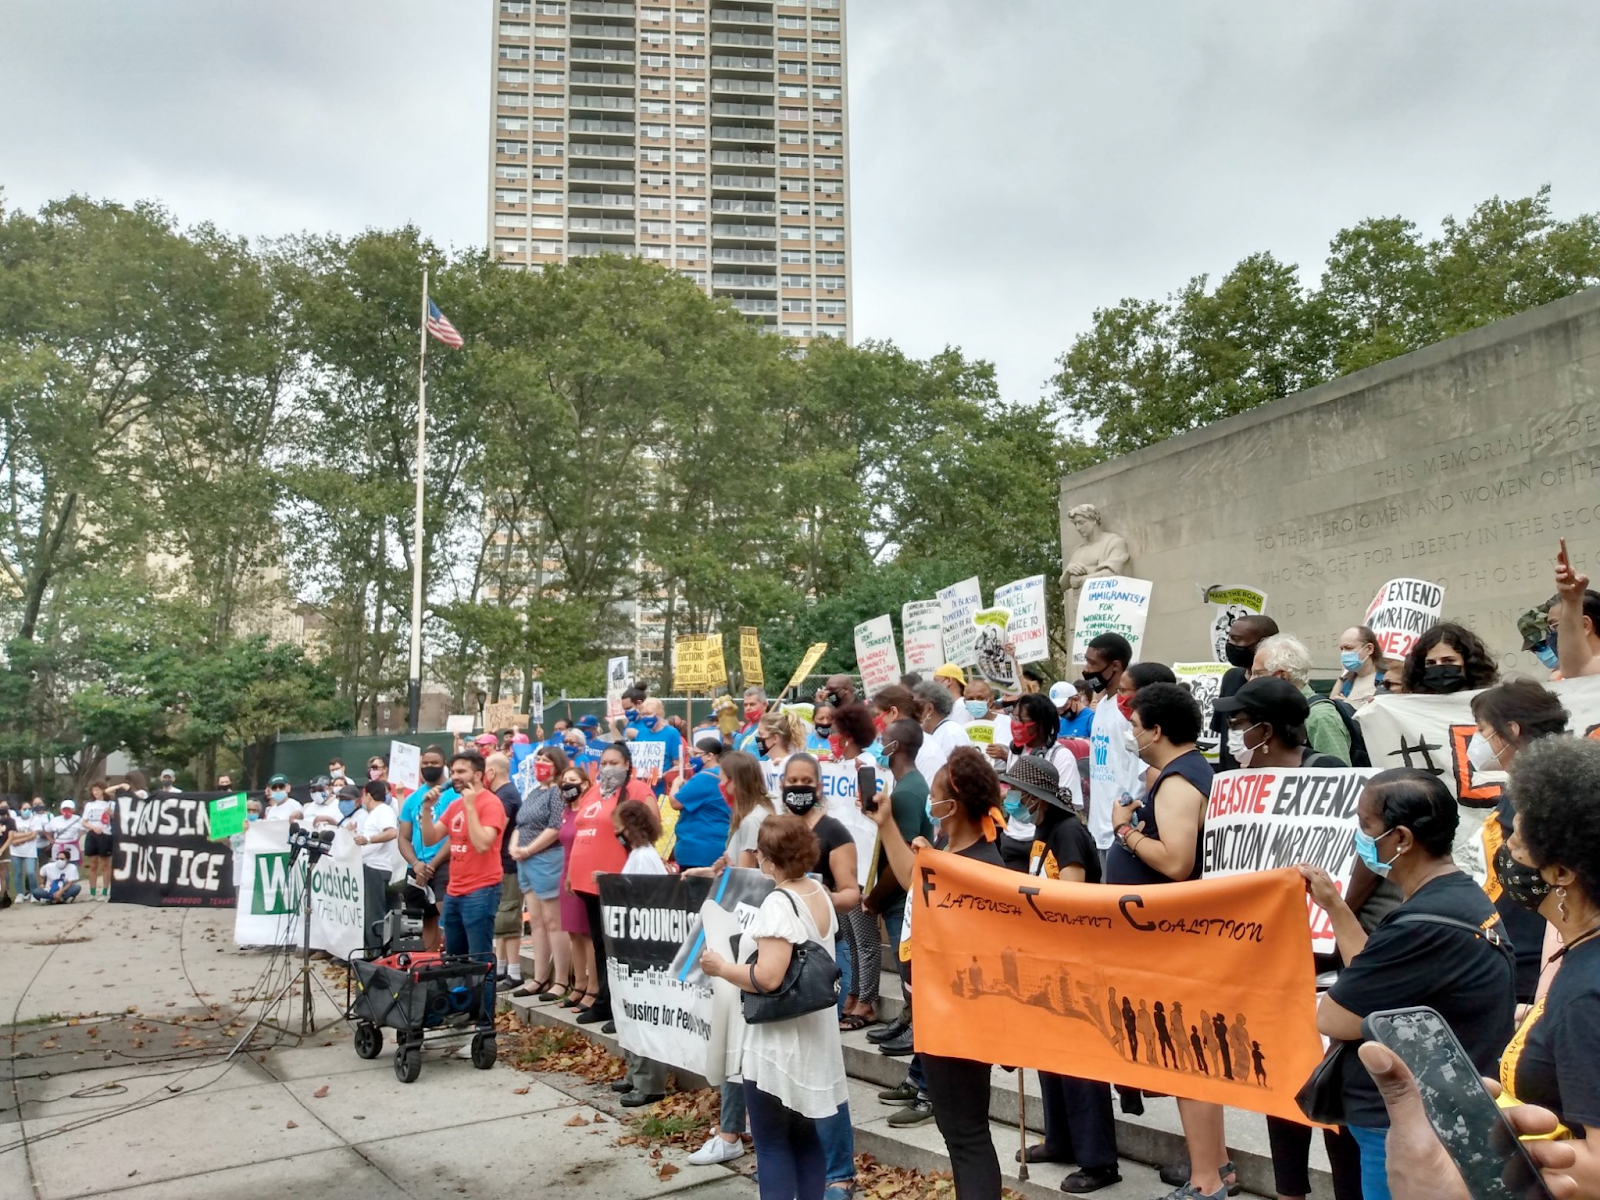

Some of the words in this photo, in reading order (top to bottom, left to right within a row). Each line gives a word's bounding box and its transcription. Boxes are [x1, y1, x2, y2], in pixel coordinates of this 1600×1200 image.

[1374, 463, 1415, 487] THIS
[1423, 433, 1532, 476] MEMORIAL
[1537, 426, 1555, 446] IS
[1255, 536, 1275, 552] TO
[1279, 528, 1306, 548] THE
[1311, 514, 1371, 542] HEROIC
[1376, 501, 1410, 526] MEN
[1416, 494, 1454, 516] AND
[1460, 475, 1532, 505] WOMEN
[1540, 467, 1567, 487] OF
[1257, 567, 1292, 584] WHO
[1297, 553, 1358, 580] FOUGHT
[1364, 547, 1396, 568] FOR
[1401, 530, 1472, 560] LIBERTY
[1478, 525, 1499, 545] IN
[1504, 517, 1544, 539] THE
[1088, 579, 1118, 591] DEFEND
[1459, 561, 1538, 590] THOSE
[1089, 590, 1146, 607] IMMIGRANTS!
[1209, 592, 1228, 600] MAKE
[1243, 592, 1262, 604] ROAD
[1246, 599, 1260, 609] YORK
[1388, 581, 1441, 608] EXTEND
[1099, 603, 1114, 611] FOR
[1030, 616, 1038, 625] TO
[1086, 622, 1132, 633] COMMUNITY
[678, 651, 705, 662] EVICTIONS
[679, 642, 691, 650] STOP
[693, 641, 703, 650] ALL
[678, 665, 691, 674] STOP
[693, 664, 703, 673] ALL
[974, 727, 993, 735] ROAD
[1208, 774, 1276, 819] HEASTIE
[1204, 822, 1272, 873] EVICTION
[113, 842, 225, 891] JUSTICE
[920, 866, 1022, 916] FLATBUSH
[1018, 885, 1112, 929] TENANT
[1118, 894, 1264, 942] COALITION
[629, 907, 687, 943] COUNCIL
[622, 998, 659, 1025] Housing
[662, 1005, 675, 1027] for
